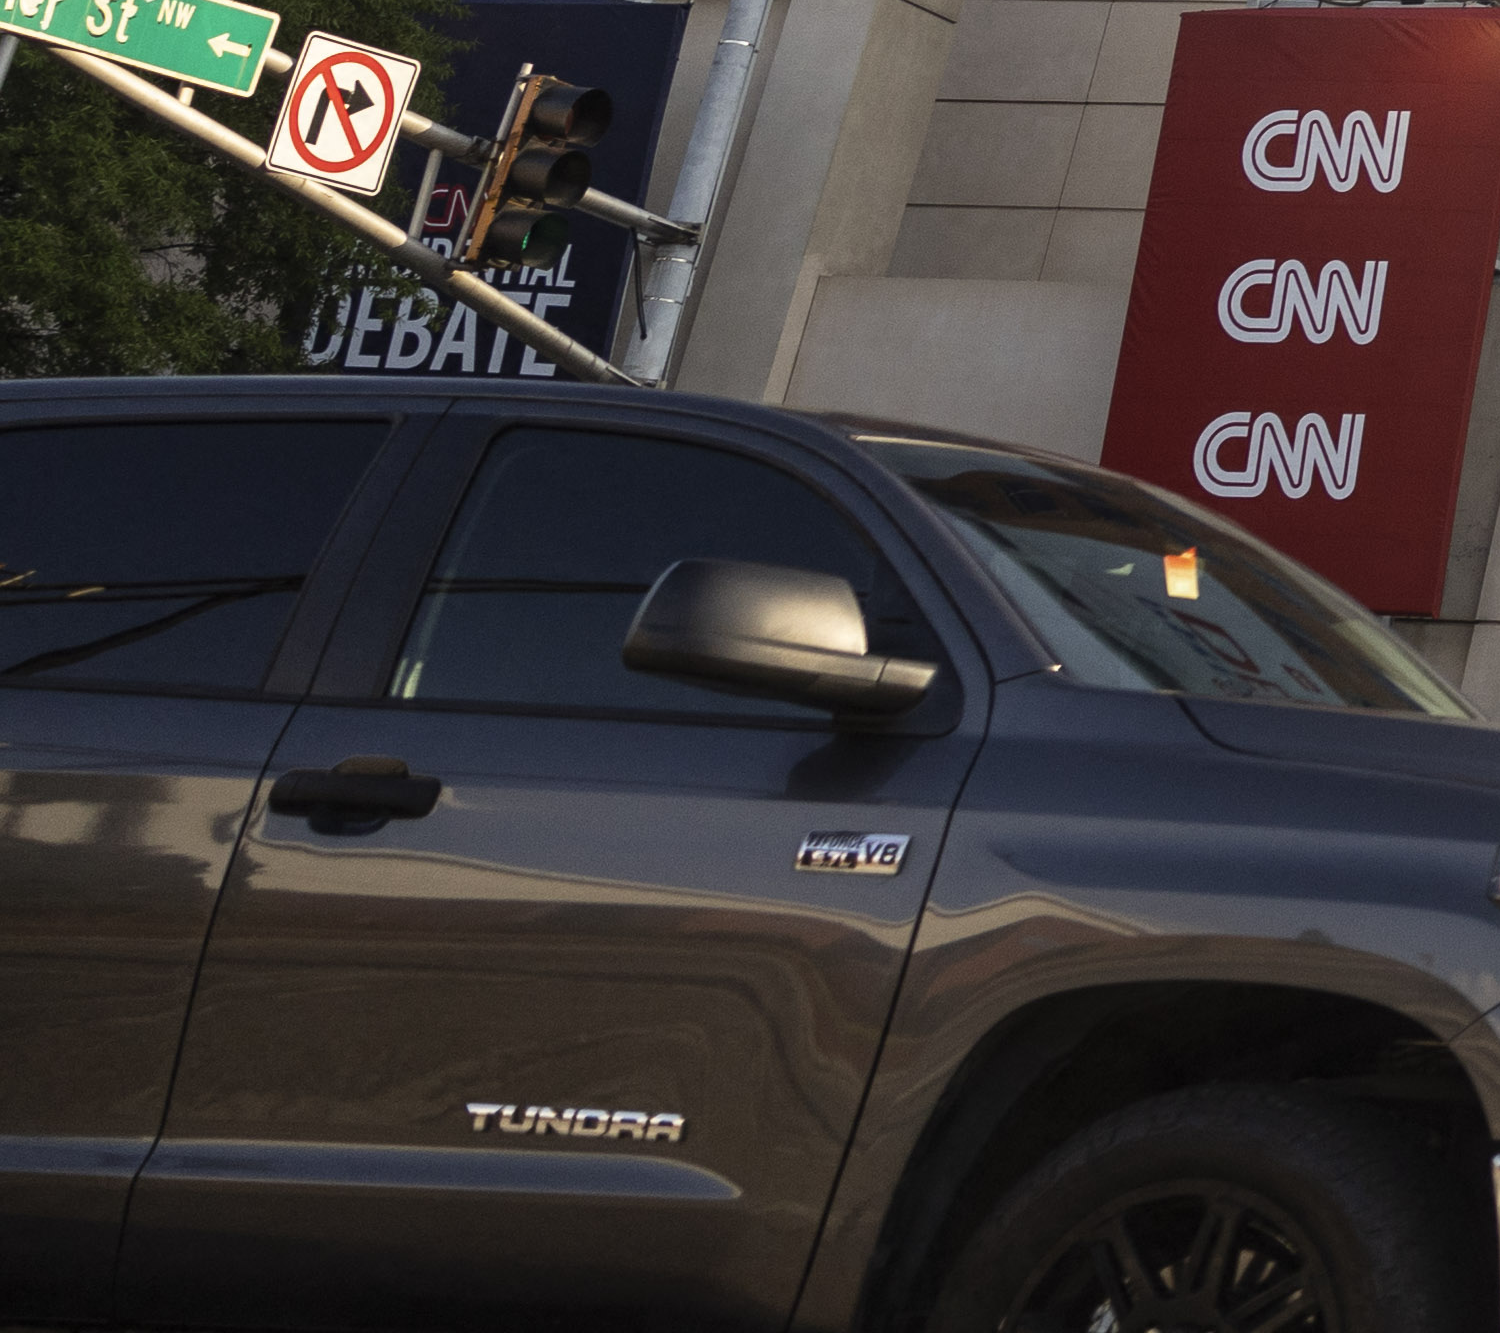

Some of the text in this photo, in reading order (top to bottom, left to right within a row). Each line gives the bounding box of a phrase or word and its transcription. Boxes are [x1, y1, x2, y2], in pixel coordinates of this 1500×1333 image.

[1242, 109, 1411, 193] CNN
[1217, 259, 1389, 345] CNN
[1193, 412, 1366, 500] CNN
[863, 842, 900, 866] V8
[466, 1102, 686, 1144] TUNDRA
